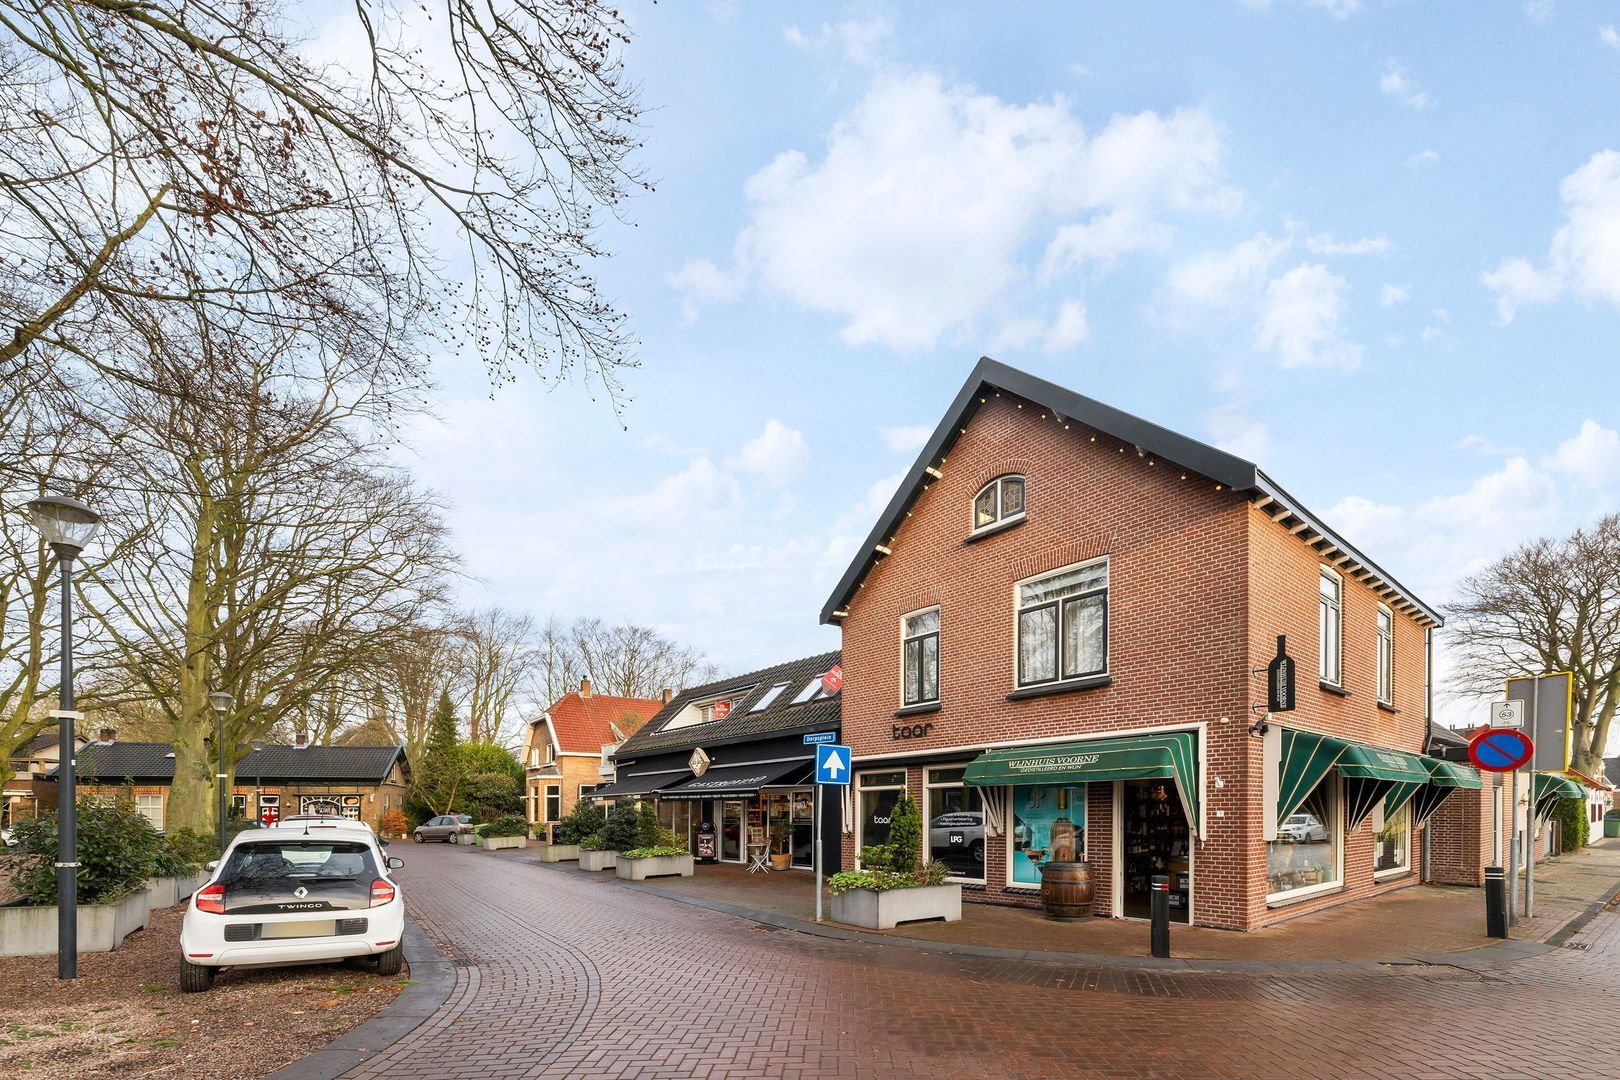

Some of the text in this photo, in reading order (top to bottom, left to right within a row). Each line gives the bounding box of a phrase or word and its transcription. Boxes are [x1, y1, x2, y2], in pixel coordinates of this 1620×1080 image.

[891, 722, 933, 740] taar
[1008, 755, 1100, 768] WIJNHUIS VOORNE
[873, 815, 892, 824] taar
[950, 835, 963, 843] LPG
